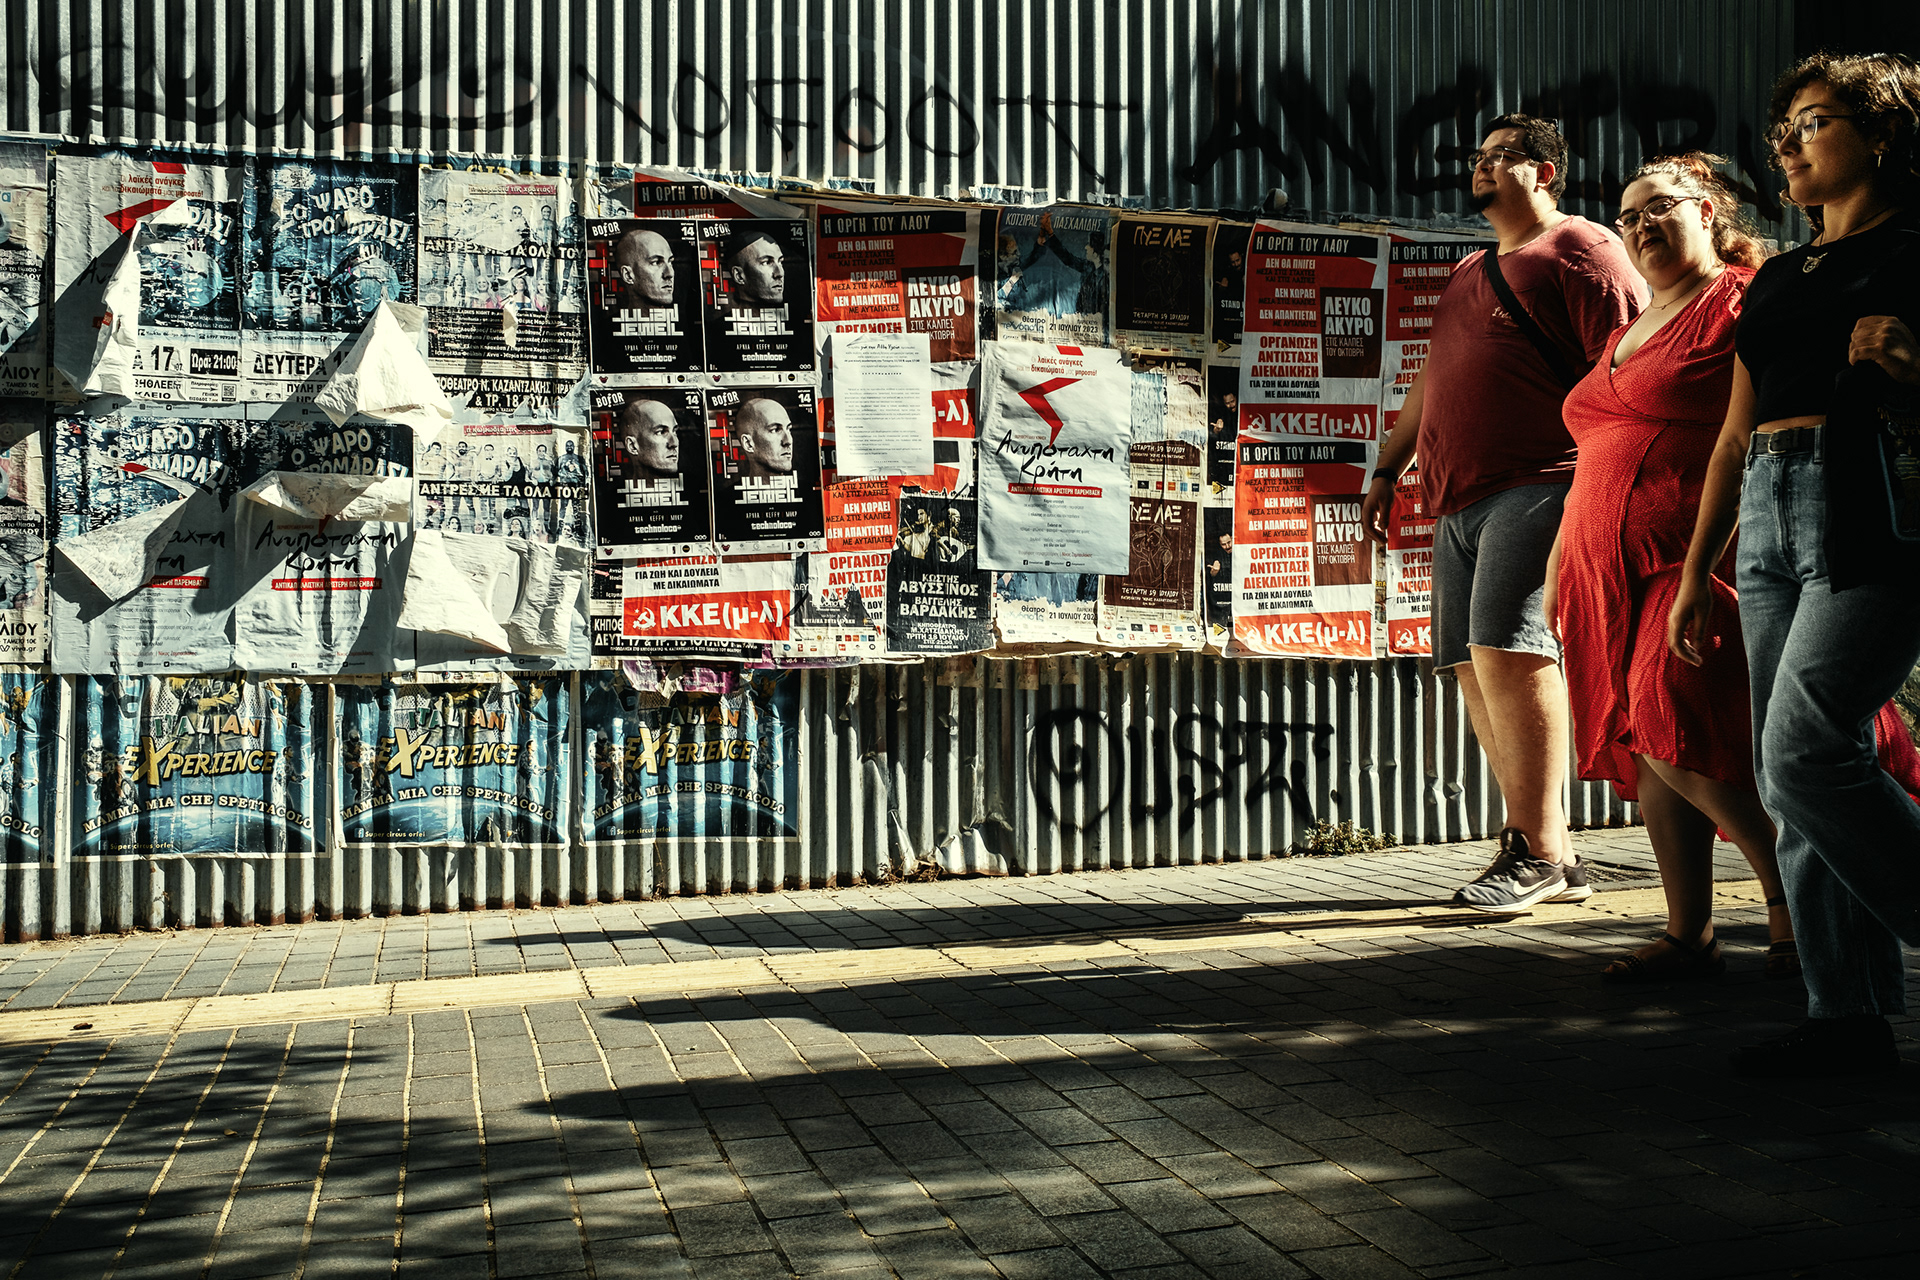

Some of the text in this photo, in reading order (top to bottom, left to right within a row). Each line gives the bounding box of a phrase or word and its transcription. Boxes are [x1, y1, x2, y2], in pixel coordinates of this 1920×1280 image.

[155, 177, 185, 187] ανάγκες
[312, 186, 374, 212] ΨΑΡΟ
[656, 185, 686, 201] ΟΡΓΗ
[824, 215, 930, 234] Η ΟΡΓΗ ΤΟΥ ΛΑΟΥ
[1005, 213, 1101, 232] ΚΟΤΣΙΡΑΣ ΠΑΣΧΑΛΙΔΗΣ
[681, 227, 694, 236] 14
[791, 227, 803, 236] 14
[838, 240, 894, 251] ΔΕΝ ΘΑ ΠΝΙΓΕΙ
[1256, 236, 1349, 253] Η ΟΡΓΗ ΤΟΥ ΛΑΟΥ
[1392, 246, 1450, 260] Η ΟΡΓΗ ΤΟΥ
[908, 275, 961, 297] ΛΕΥΚΟ
[834, 294, 899, 307] ΔΕΝ ΑΠΑΝΤΙΕΤΑΙ
[910, 296, 965, 318] ΑΚΥΡΟ
[1221, 300, 1240, 308] STAND
[1325, 296, 1371, 316] ΛΕΥΚΟ
[1049, 324, 1057, 332] 21
[1058, 324, 1081, 332] ΙΟΥΛΙΟΥ
[1082, 325, 1098, 333] 2023
[1325, 317, 1373, 336] ΑΚΥΡΟ
[1260, 336, 1318, 349] ΟΡΓΑΝΩΣΗ
[151, 345, 174, 370] 17
[1258, 351, 1318, 364] ΑΝΤΙΣΤΑΣΗ
[1326, 348, 1364, 357] ΤΟΥ ΟΚΤΩΒΡΗ
[253, 355, 327, 375] ΔΕΥΤΕΡΑ
[1251, 365, 1319, 378] ΔΙΕΚΔΙΚΗΣΗ
[287, 384, 313, 392] ΠΥΛΗ
[686, 395, 699, 405] 14
[799, 394, 811, 403] 14
[313, 429, 372, 455] ΨΑΡΟ
[996, 430, 1114, 463] Ανυπόταχτη
[1243, 445, 1336, 461] Η ΟΡΓΗ ΤΟΥ ΛΑΟΥ
[1018, 456, 1082, 497] Κρήτη
[1254, 468, 1304, 479] ΔΕΝ ΘΑ ΠΝΙΓΕΙ
[420, 483, 476, 496] ΑΝΤΡΕΣ
[503, 486, 521, 497] ΤΑ
[524, 486, 551, 498] ΟΛΑ
[844, 501, 890, 514] ΔΕΝ ΧΩΡΑΕΙ
[1265, 497, 1306, 508] ΔΕΝ ΧΩΡΑΕΙ
[864, 512, 891, 520] ΚΑΛΠΕΣ
[1315, 503, 1362, 523] ΛΕΥΚΟ
[1316, 523, 1364, 543] ΑΚΥΡΟ
[1251, 546, 1309, 560] ΟΡΓΑΝΩΣΗ
[1317, 544, 1355, 554] ΣΤΙΣ ΚΑΛΠΕΣ
[284, 545, 360, 580] Κρήτη
[1317, 554, 1355, 564] ΤΟΥ ΟΚΤΩΒΡΗ
[635, 568, 719, 579] ΓΙΑ ΖΩΗ ΚΑΙ ΔΟΥΛΕΙΑ
[1250, 561, 1310, 574] ΑΝΤΙΣΤΑΣΗ
[653, 579, 720, 590] ΜΕ ΔΙΚΑΙΩΜΑΤΑ
[922, 574, 959, 583] ΚΩΣΤΗΣ
[1244, 575, 1311, 589] ΔΙΕΚΔΙΚΗΣΗ
[899, 581, 978, 596] ΑΒΥΣΣΙΝΟΣ
[1242, 590, 1312, 600] ΓΙΑ ΖΩΗ ΚΑΙ ΔΟΥΛΕΙΑ
[915, 597, 962, 606] ΒΑΓΓΕΛΗΣ
[1258, 600, 1314, 610] ΜΕ ΔΙΚΑΙΩΜΑΤΑ
[1396, 595, 1421, 604] ΓΙΑ ΖΩΗ
[900, 604, 977, 618] ΒΑΡΔΑΚΗΣ
[1022, 605, 1045, 613] Θέατρο
[409, 706, 506, 730] ITALIAN
[650, 706, 741, 728] ITALIAN
[153, 714, 261, 738] ITALIAN
[341, 786, 554, 820] MAMMA MIA CHE SPETTACOLO
[592, 781, 786, 819] MAMMA MIA CHE SPETTACOLO
[82, 794, 313, 833] MAMMA MIA CHE SPETTACOLO
